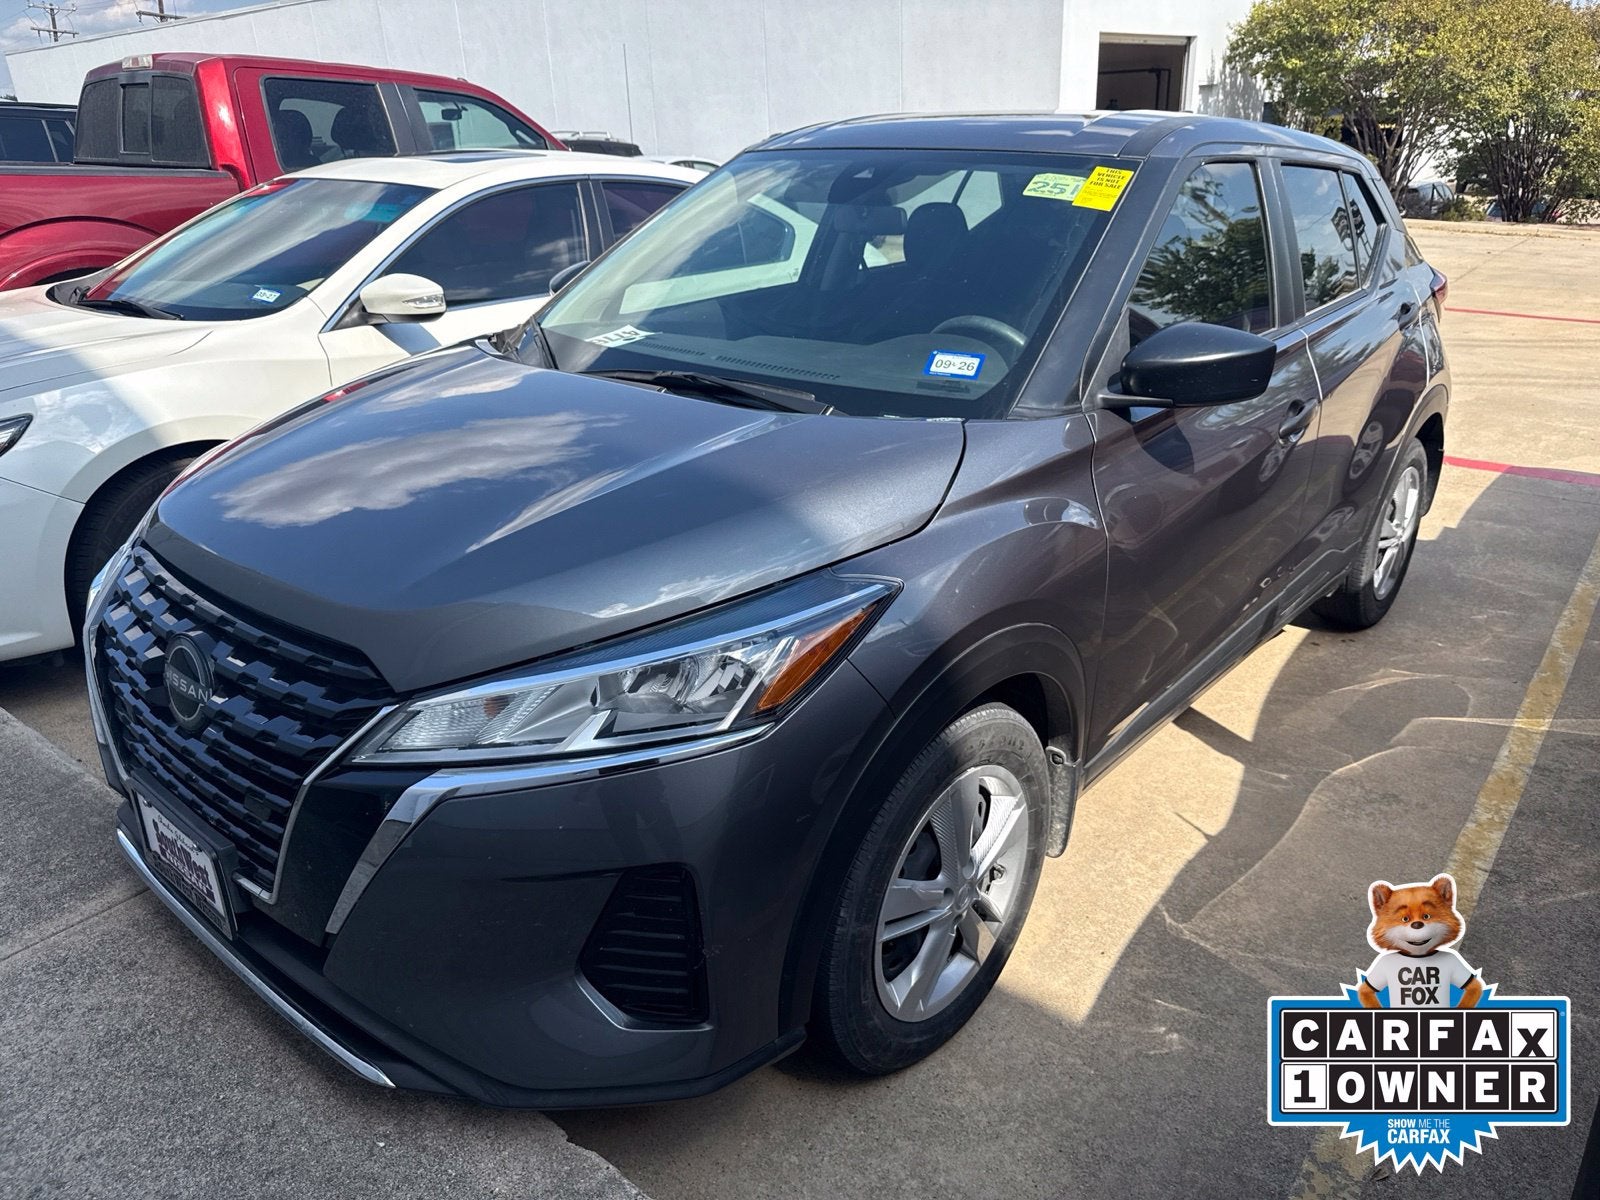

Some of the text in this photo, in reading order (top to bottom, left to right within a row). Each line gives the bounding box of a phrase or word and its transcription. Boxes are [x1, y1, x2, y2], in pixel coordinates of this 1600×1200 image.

[1097, 172, 1126, 180] VEHICLE
[957, 361, 976, 372] 26
[165, 669, 213, 703] NISSAN
